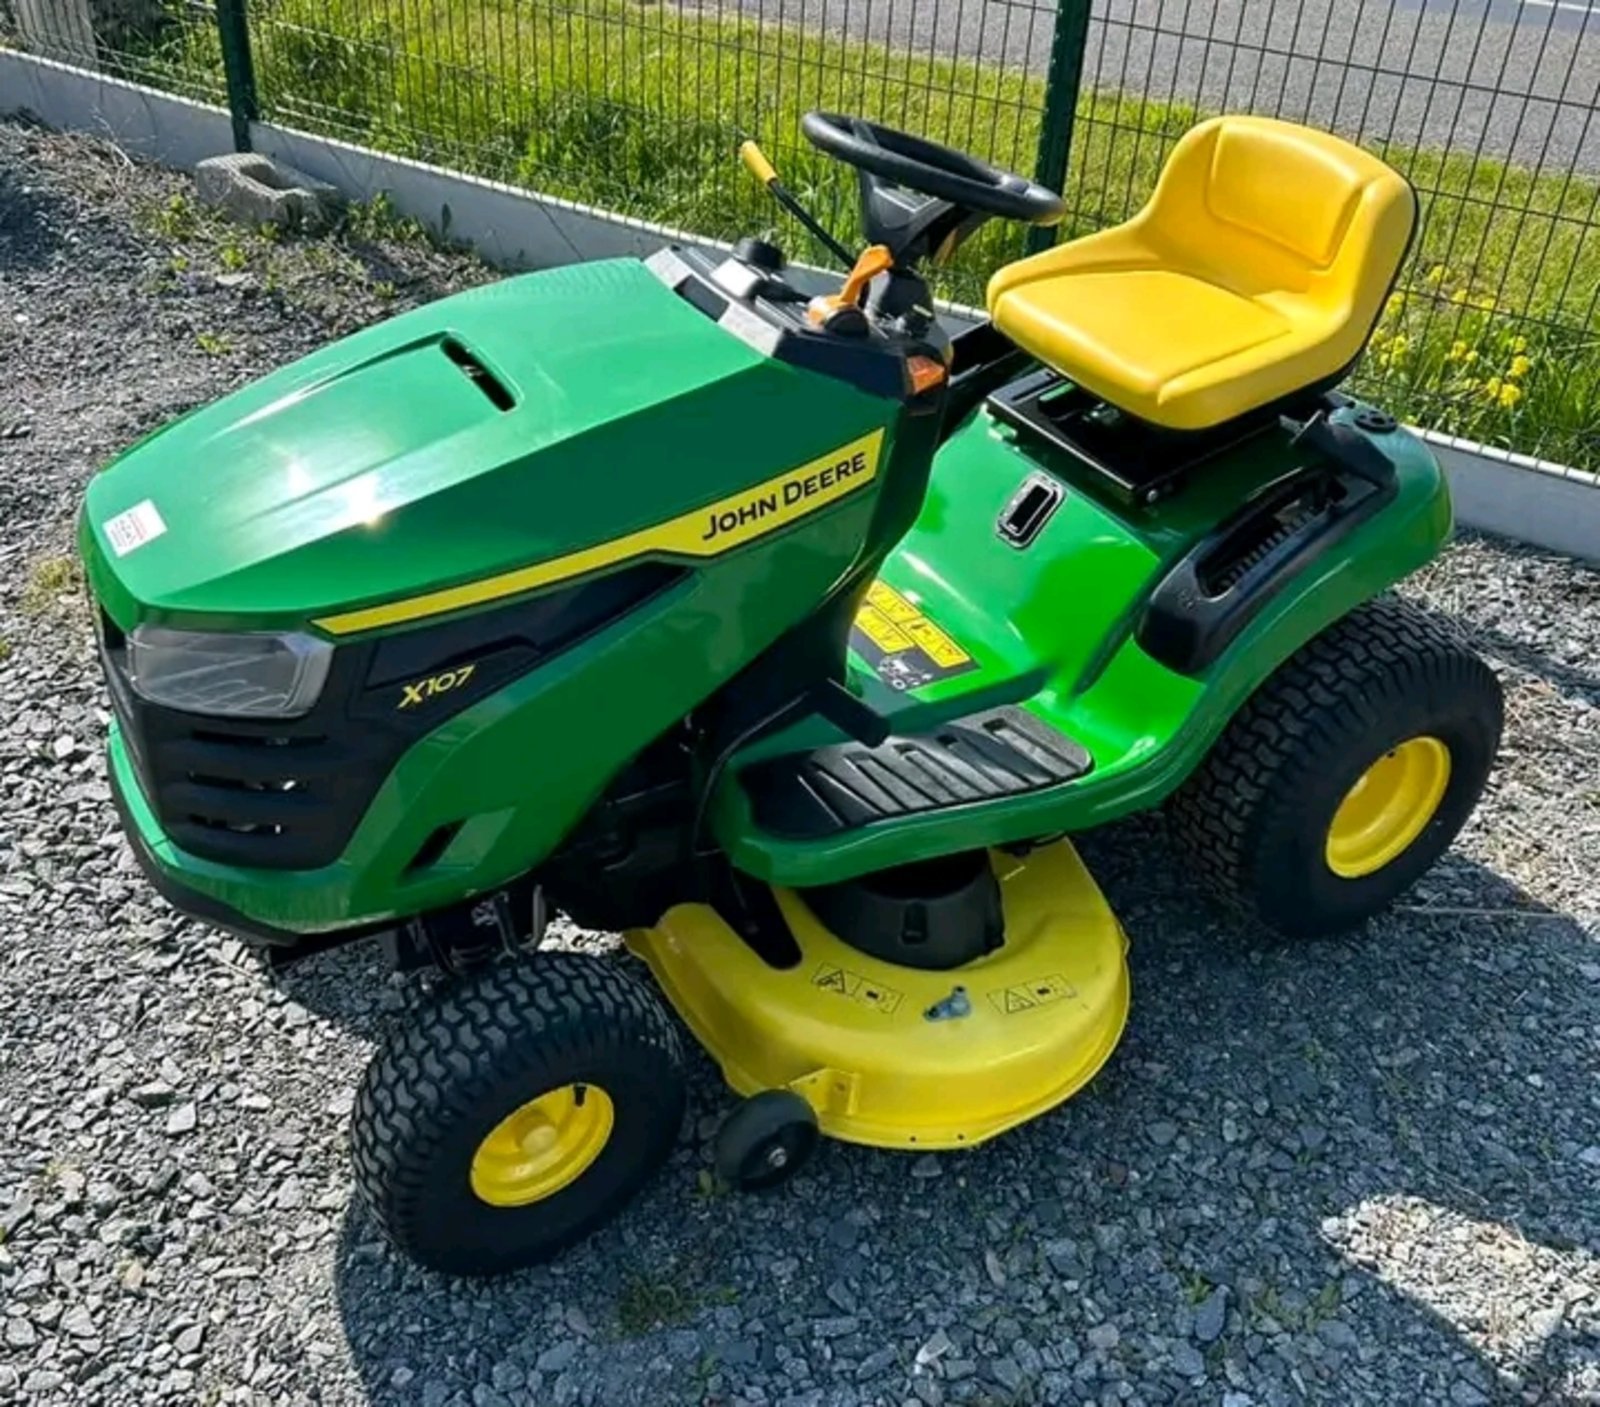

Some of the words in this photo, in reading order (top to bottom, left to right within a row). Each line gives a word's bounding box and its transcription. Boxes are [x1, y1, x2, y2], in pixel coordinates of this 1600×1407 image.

[702, 494, 777, 540] JOHN
[783, 452, 867, 506] DEERE
[397, 664, 476, 709] X107
